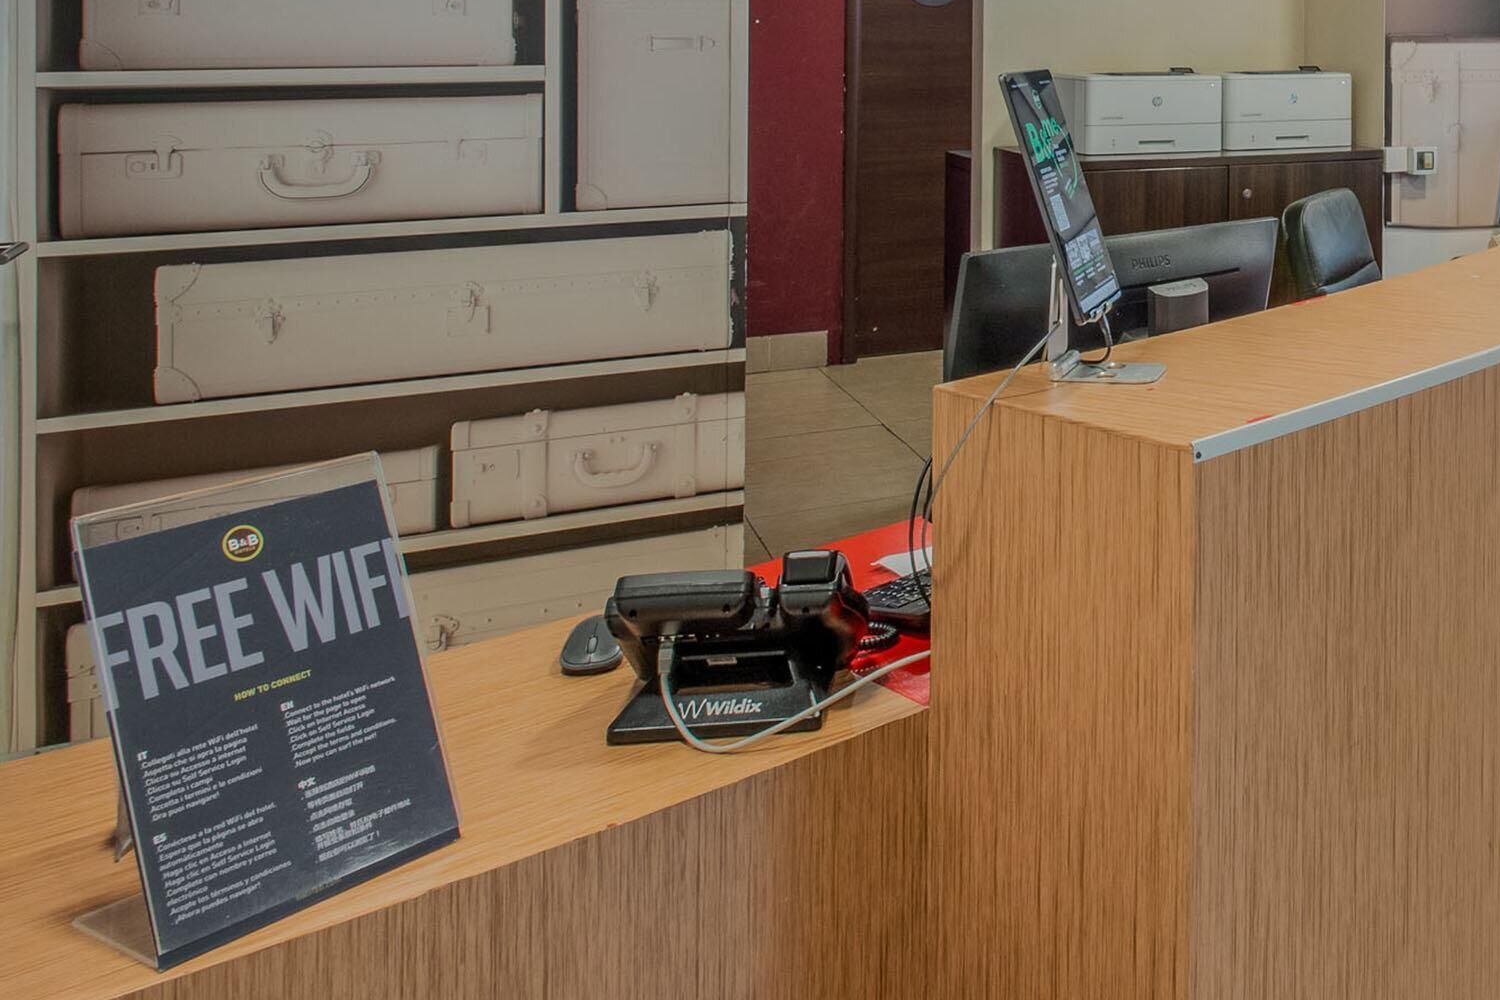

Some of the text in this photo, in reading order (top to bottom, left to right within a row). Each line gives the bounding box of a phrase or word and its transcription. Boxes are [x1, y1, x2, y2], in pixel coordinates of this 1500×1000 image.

[1131, 254, 1172, 271] PHILIPS
[228, 533, 259, 551] B&B
[88, 577, 265, 712] FREE
[234, 669, 312, 702] HOW TO CONNECT
[280, 700, 294, 712] EN
[706, 698, 763, 716] Wildix
[137, 750, 148, 761] IT
[153, 832, 167, 845] ES
